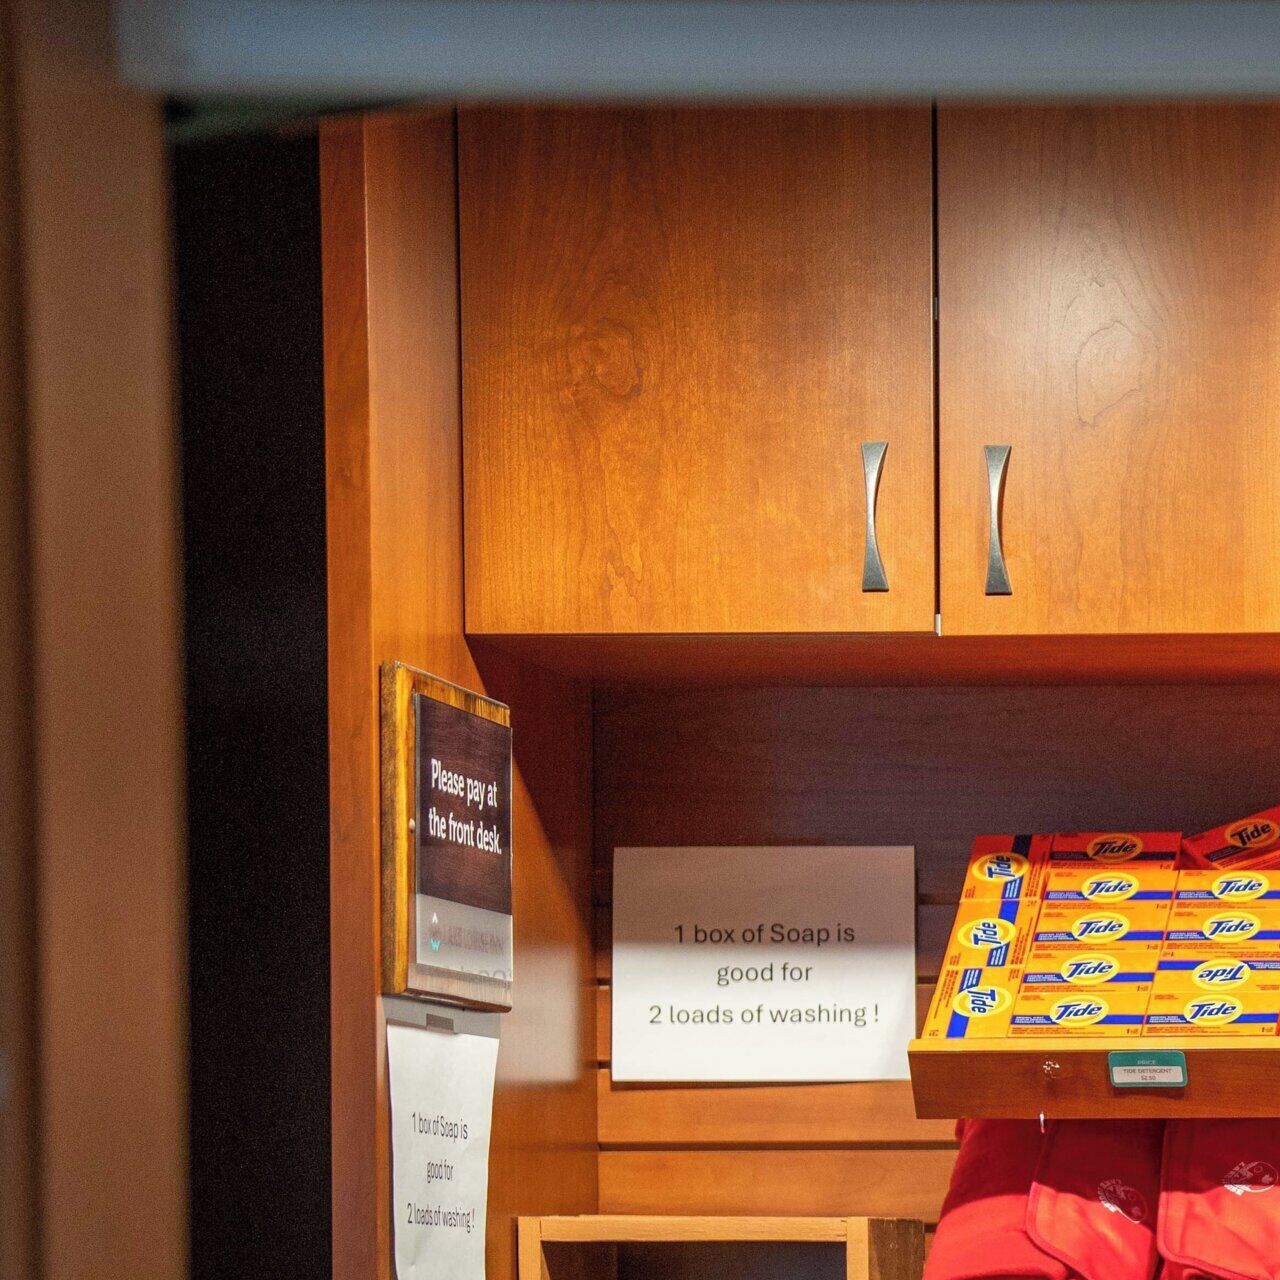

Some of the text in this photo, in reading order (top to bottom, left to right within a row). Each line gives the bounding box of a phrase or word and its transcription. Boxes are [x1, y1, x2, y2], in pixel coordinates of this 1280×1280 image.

[431, 758, 497, 810] Please pay at
[429, 807, 502, 854] the front desk.
[674, 923, 855, 947] 1 box of Soap is
[1077, 920, 1123, 938] Tide
[1206, 918, 1255, 937] Tide
[717, 962, 813, 986] good for
[1064, 961, 1114, 981] Tide
[649, 1003, 878, 1027] 2 loads of washing !
[1052, 1003, 1102, 1023] Tide
[1188, 1001, 1237, 1021] Tide
[412, 1112, 468, 1143] 1 box of Soap is
[427, 1160, 453, 1183] good for
[407, 1203, 413, 1224] 2
[414, 1203, 433, 1226] loads
[434, 1204, 441, 1227] of
[441, 1205, 471, 1234] washing
